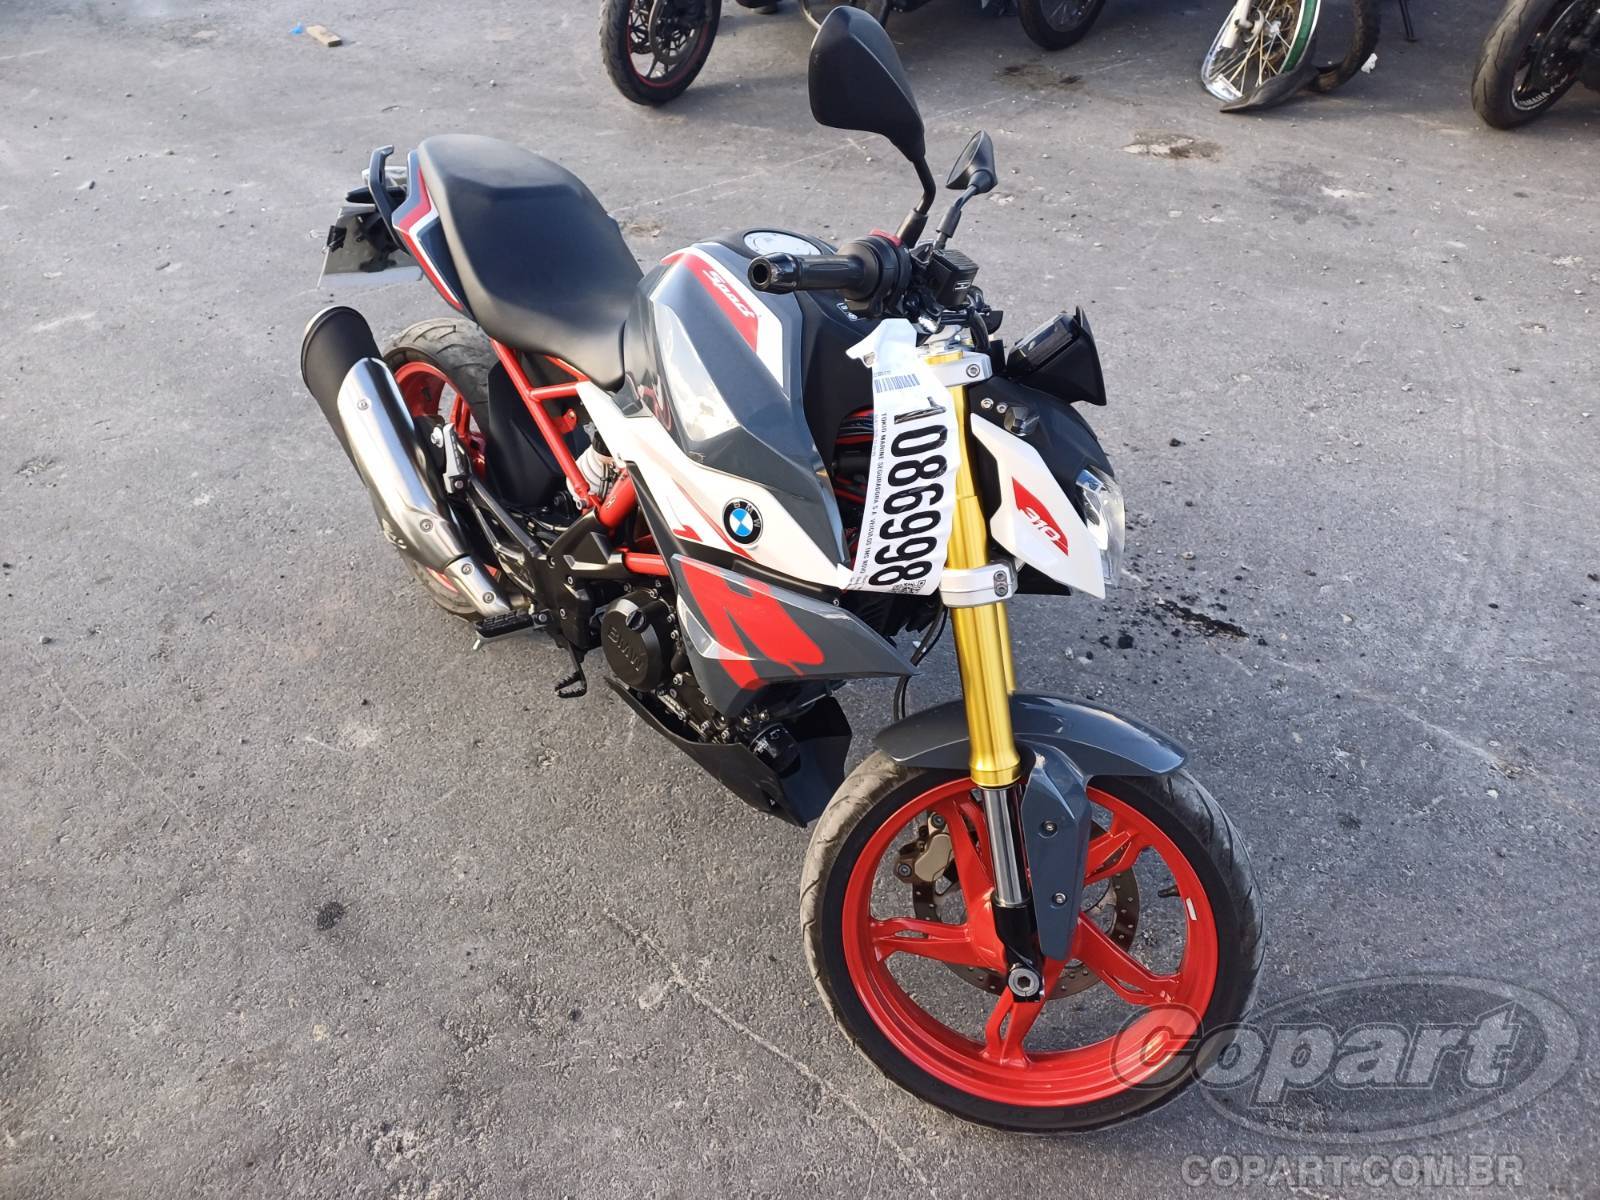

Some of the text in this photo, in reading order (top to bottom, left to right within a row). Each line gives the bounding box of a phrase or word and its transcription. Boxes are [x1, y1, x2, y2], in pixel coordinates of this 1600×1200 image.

[878, 434, 886, 460] MARINE
[867, 396, 948, 586] 1086998
[733, 501, 761, 528] BMW
[1023, 507, 1060, 541] 310
